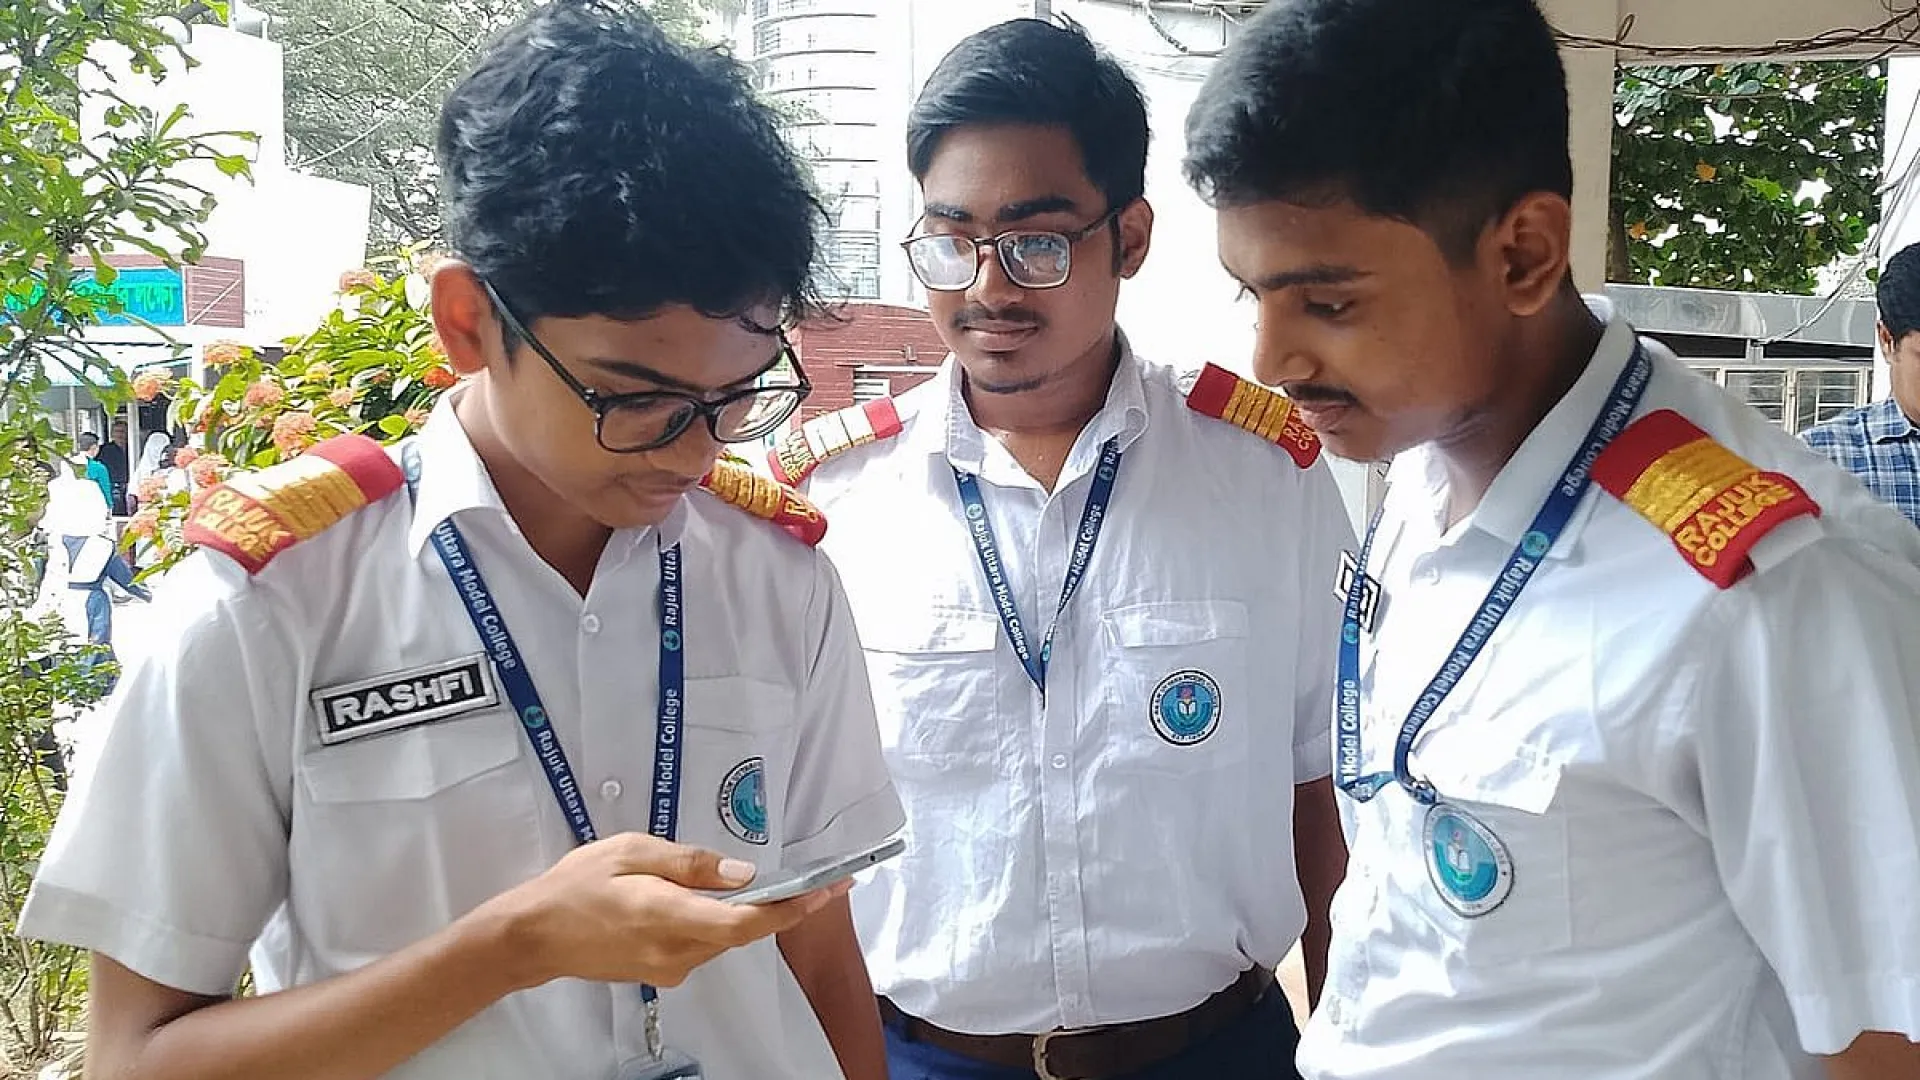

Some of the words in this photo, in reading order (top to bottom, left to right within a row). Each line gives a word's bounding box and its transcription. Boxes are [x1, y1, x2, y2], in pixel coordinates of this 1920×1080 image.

[1562, 442, 1600, 497] College
[1674, 474, 1775, 551] RAJUK
[1694, 485, 1796, 566] COLLEGE
[664, 552, 676, 580] Utta
[1494, 557, 1534, 602] Rajuk
[436, 522, 466, 568] Uttara
[458, 568, 493, 614] Model
[481, 615, 517, 670] College
[664, 584, 679, 626] Rajuk
[984, 549, 1001, 585] Uttara
[997, 584, 1016, 618] Model
[1009, 618, 1030, 660] College
[1463, 603, 1504, 650] Uttara
[332, 670, 474, 725] RASHFI
[1433, 651, 1472, 694] Model
[661, 688, 680, 745] College
[1340, 680, 1358, 731] College
[1402, 693, 1438, 743] College
[537, 730, 565, 776] Rajuk
[559, 775, 586, 825] Uttara
[656, 748, 675, 793] Model
[1340, 735, 1358, 776] Model
[653, 797, 671, 836] ttara
